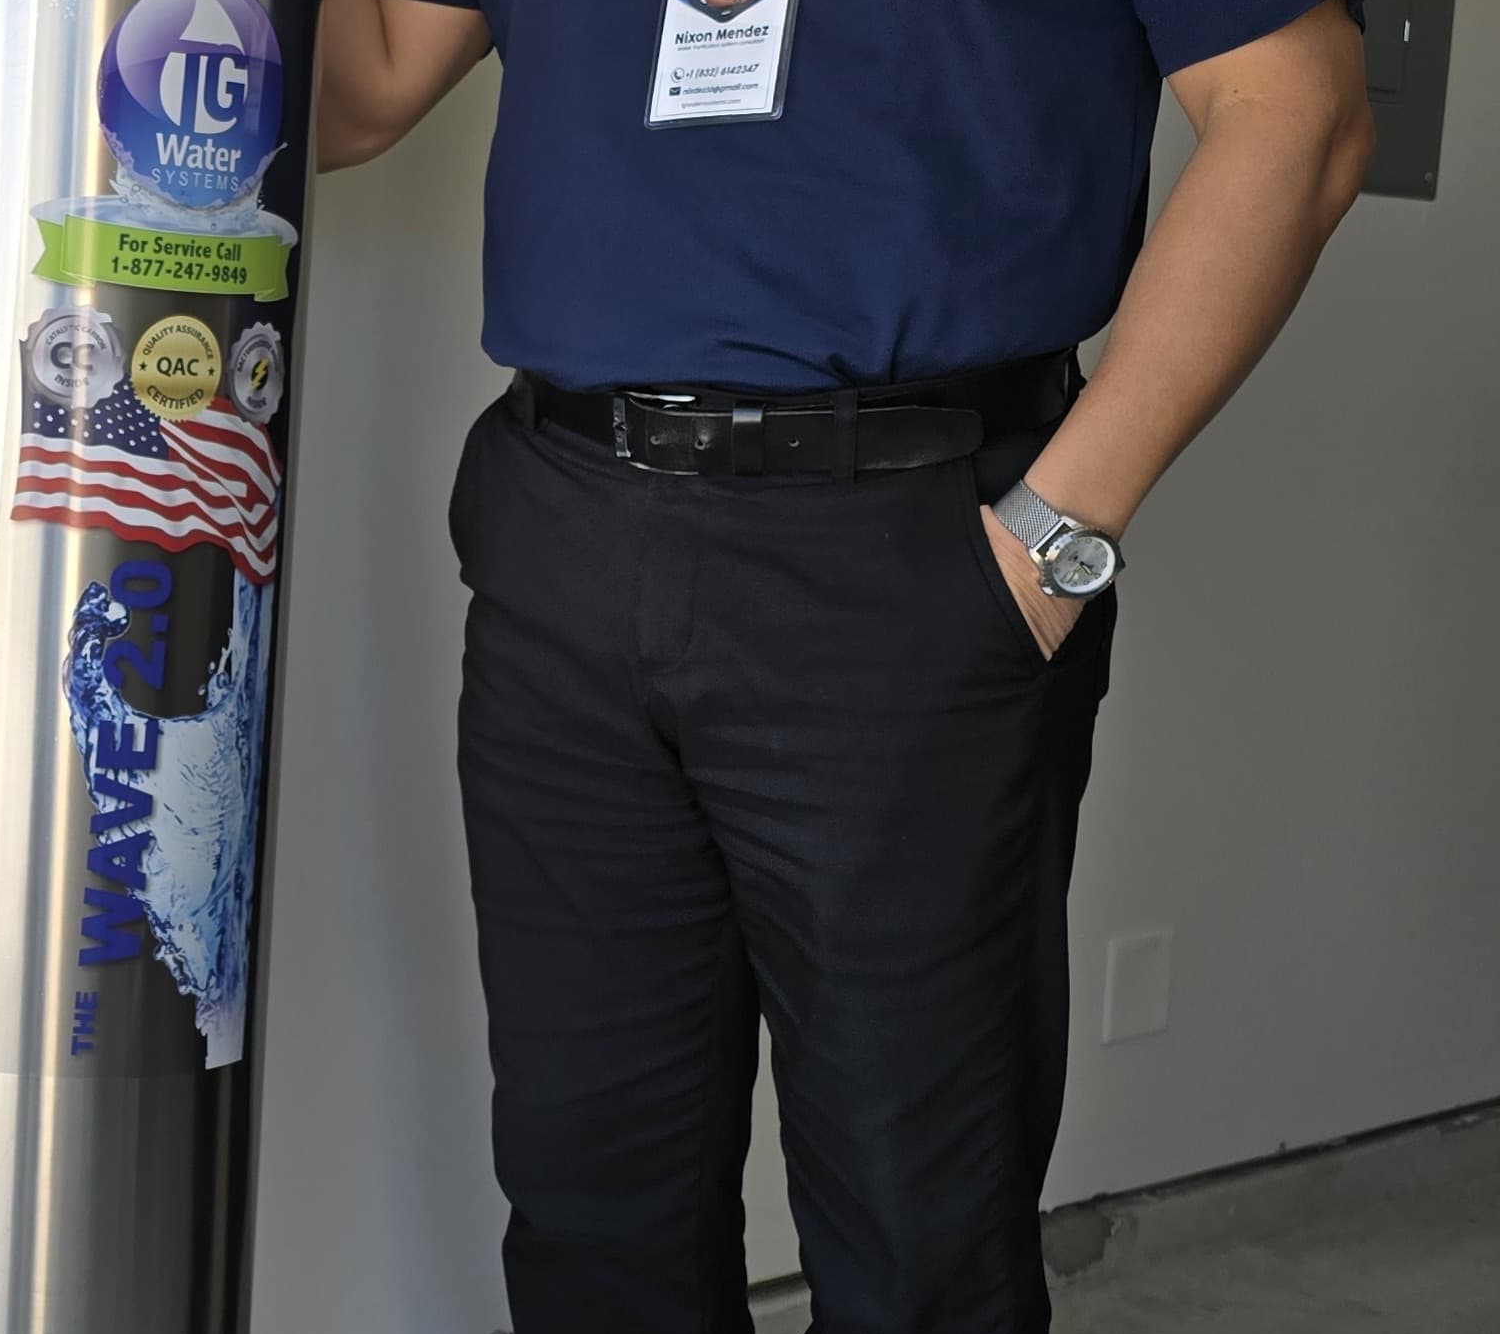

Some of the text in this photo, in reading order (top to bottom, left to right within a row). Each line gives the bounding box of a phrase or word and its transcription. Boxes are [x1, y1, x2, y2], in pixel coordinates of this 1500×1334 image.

[675, 31, 712, 45] Nixon
[716, 25, 769, 41] Mendez
[156, 132, 241, 173] Water
[151, 168, 240, 192] SYSTEMS
[119, 233, 242, 261] For Service Call
[111, 256, 247, 284] 1-877-247-9849
[142, 325, 174, 356] QUALITY
[176, 324, 214, 360] ASSURANCE
[50, 342, 95, 371] CC
[156, 356, 199, 377] QAC
[146, 384, 204, 410] CERTIFIED
[71, 559, 174, 1055] THE WAVE 2.0
